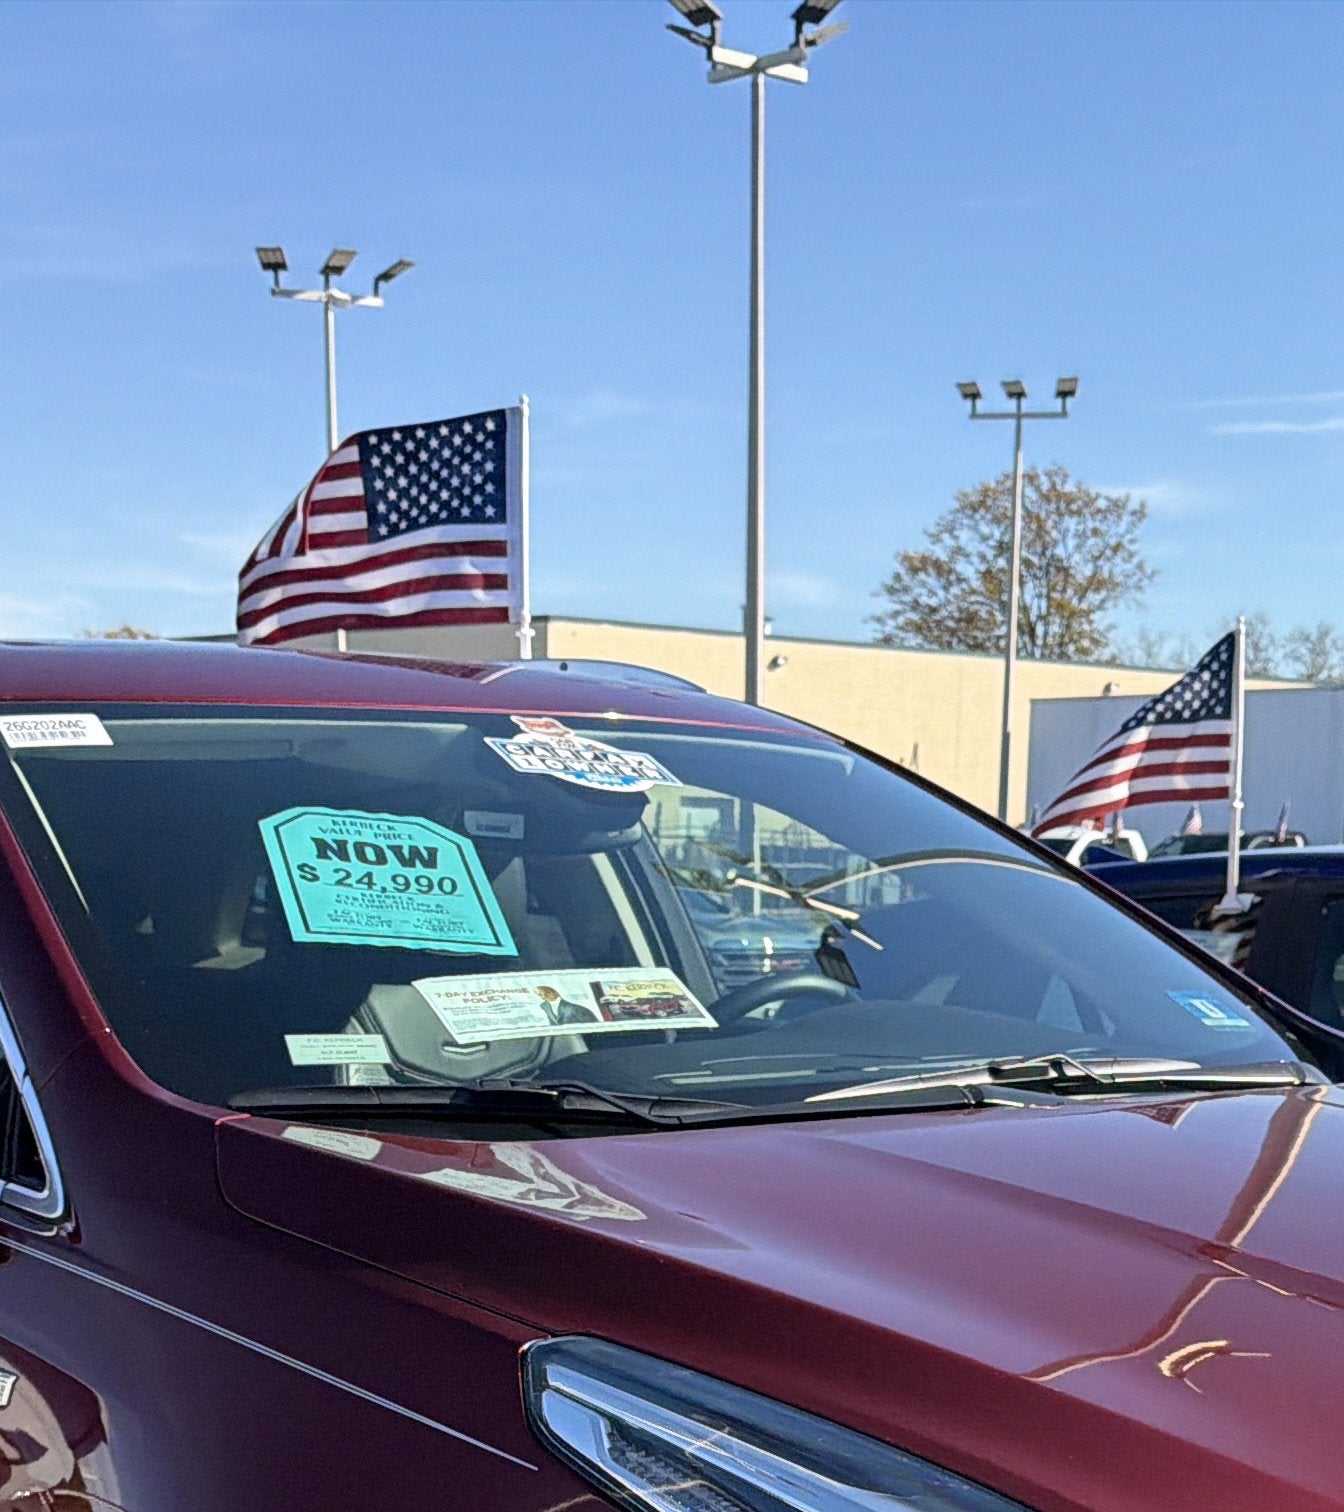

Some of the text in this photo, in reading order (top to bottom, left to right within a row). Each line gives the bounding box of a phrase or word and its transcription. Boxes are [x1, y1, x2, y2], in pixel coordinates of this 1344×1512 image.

[310, 836, 439, 869] NOW
[297, 862, 458, 896] $ 24,990
